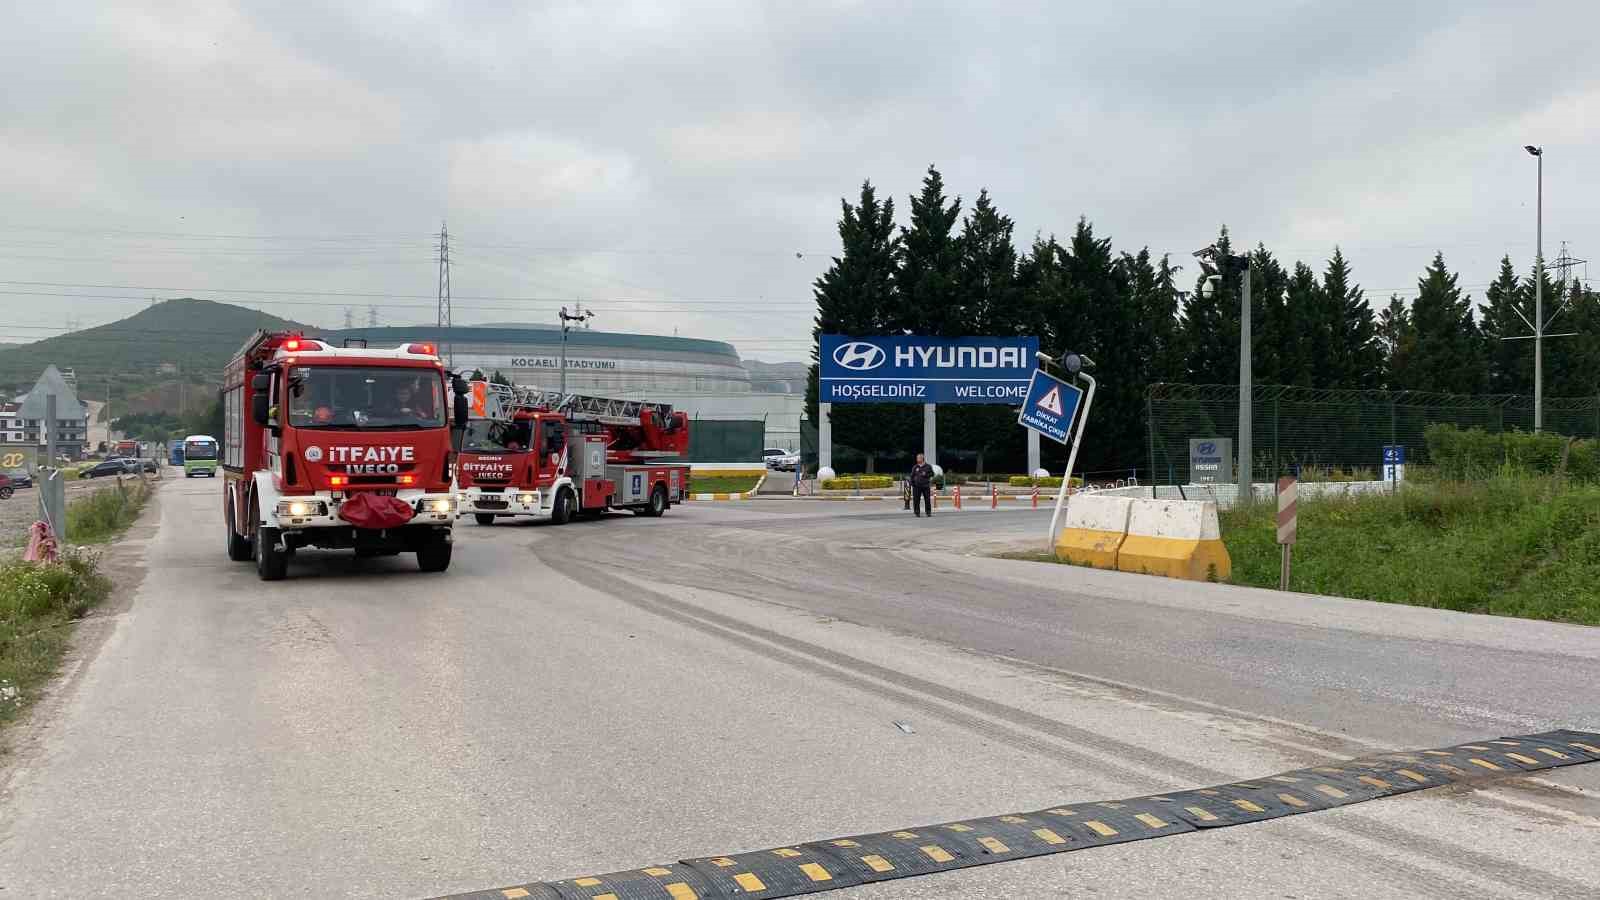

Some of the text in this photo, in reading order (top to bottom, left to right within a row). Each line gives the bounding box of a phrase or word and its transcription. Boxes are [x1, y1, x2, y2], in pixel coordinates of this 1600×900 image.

[895, 346, 1027, 369] HYUNDAI
[955, 385, 1026, 398] WELCOME
[346, 464, 399, 474] IVECO
